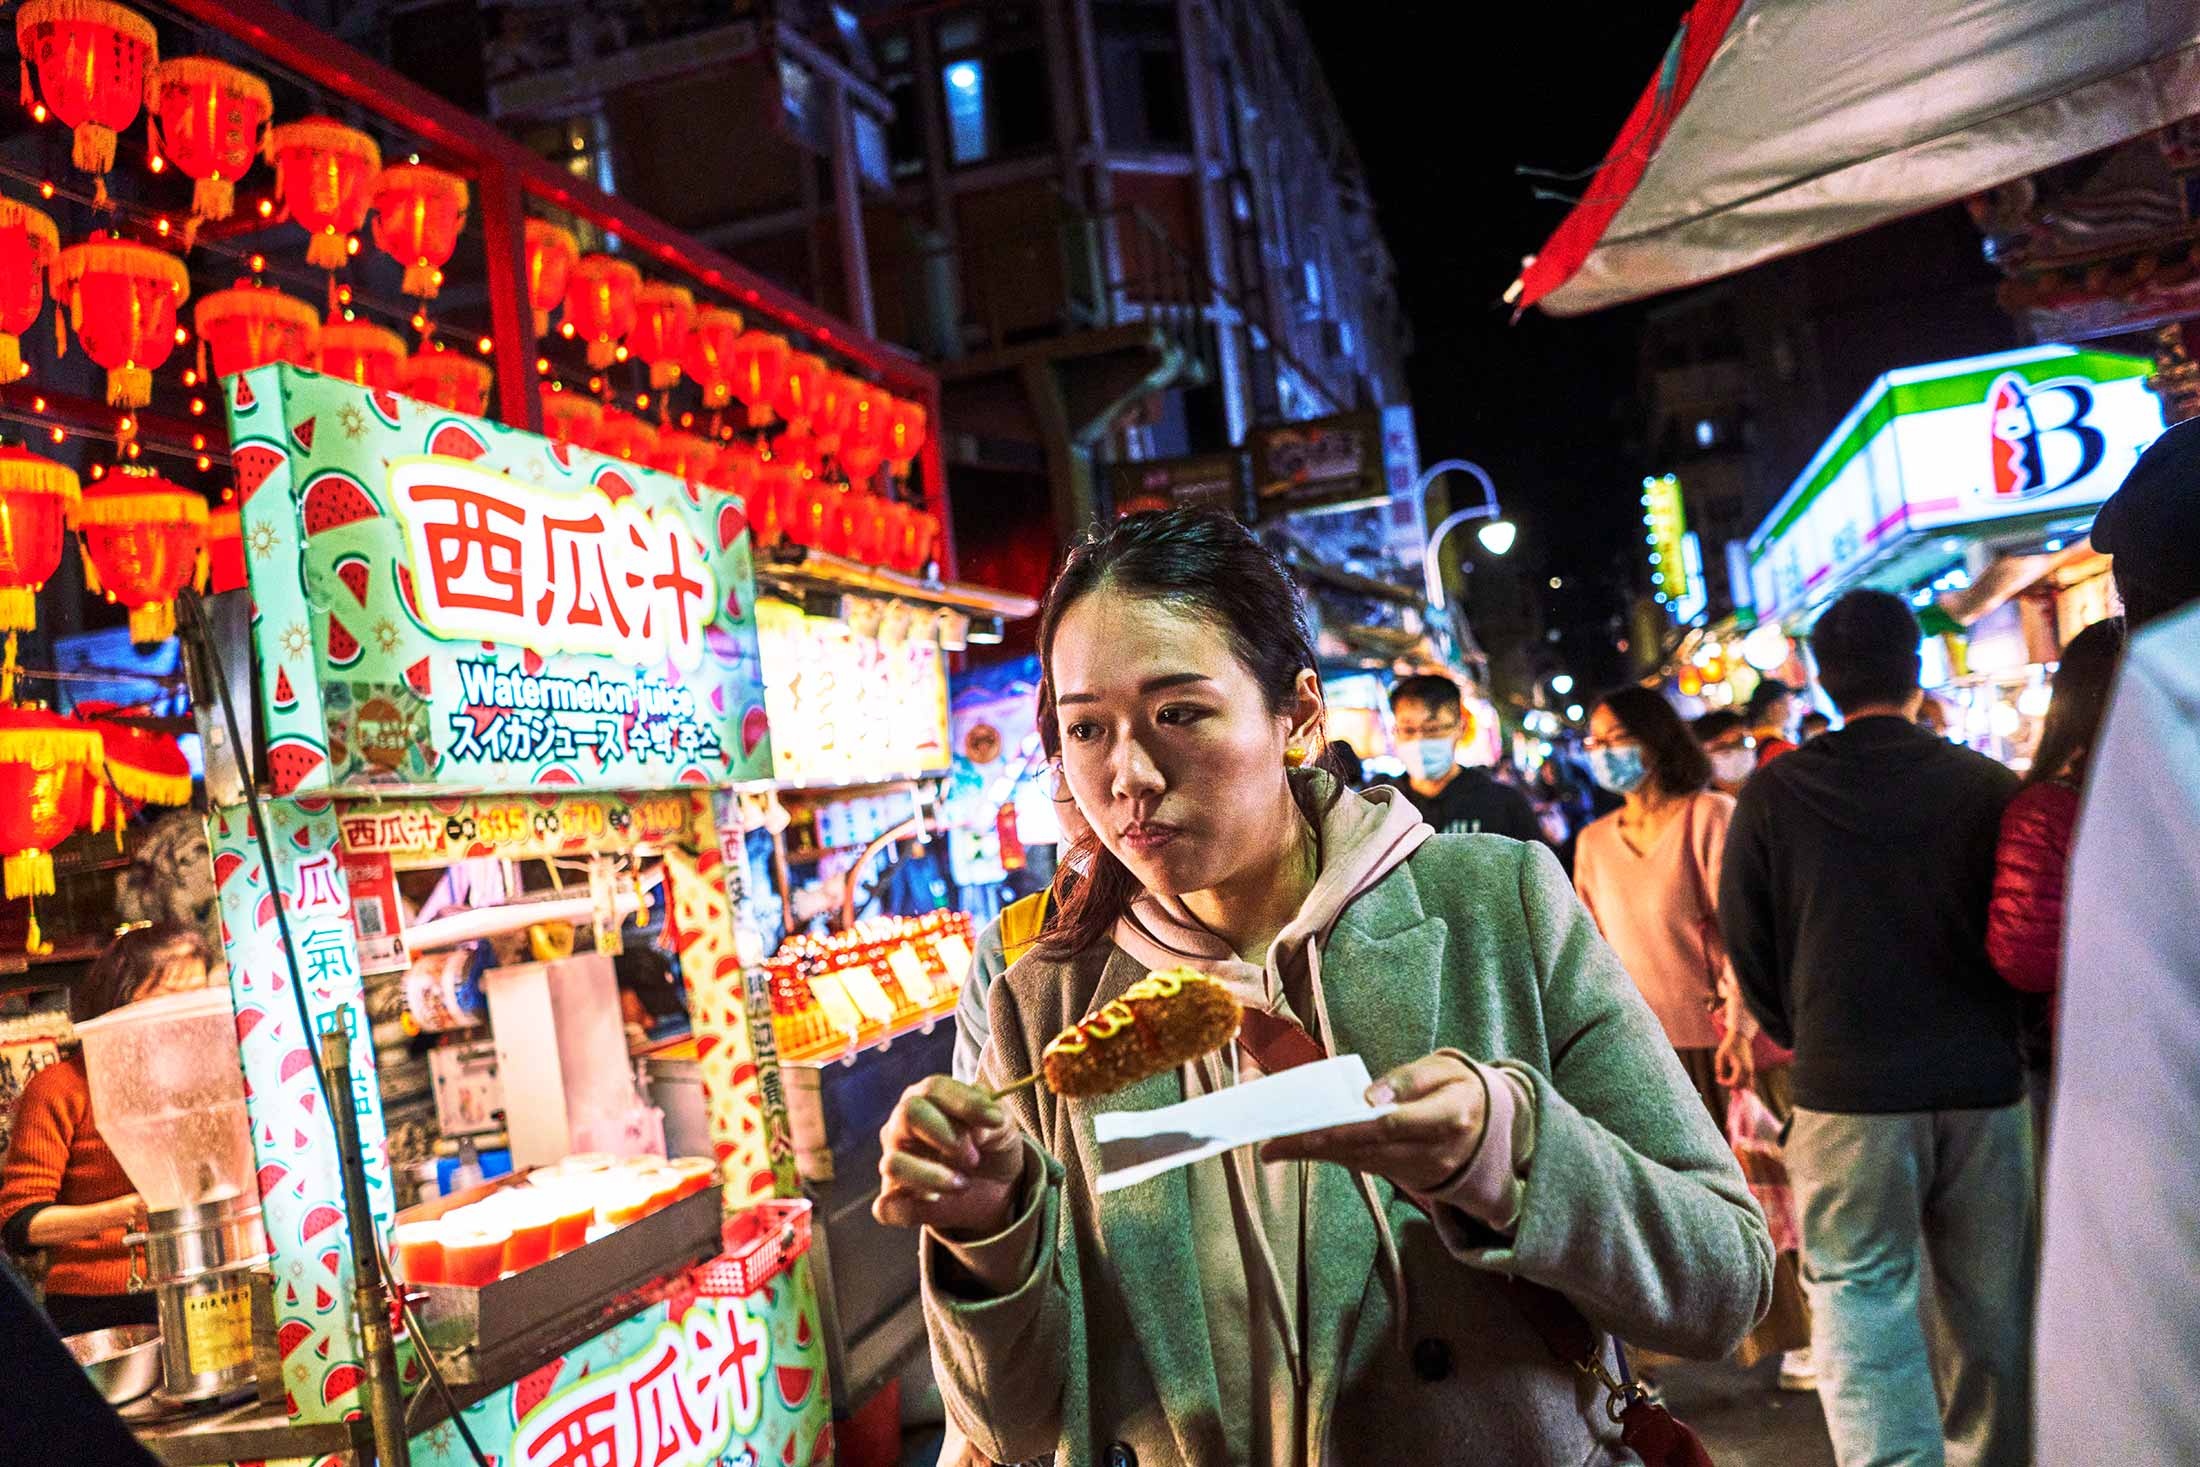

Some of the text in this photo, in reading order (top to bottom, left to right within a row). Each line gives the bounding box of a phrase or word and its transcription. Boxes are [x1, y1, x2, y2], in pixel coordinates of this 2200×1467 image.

[408, 484, 703, 646] 西瓜汁
[457, 659, 696, 722] Watermelon juice
[450, 713, 624, 761] スイカジュース
[627, 720, 722, 763] 수박 주스
[342, 814, 437, 848] 西瓜汁
